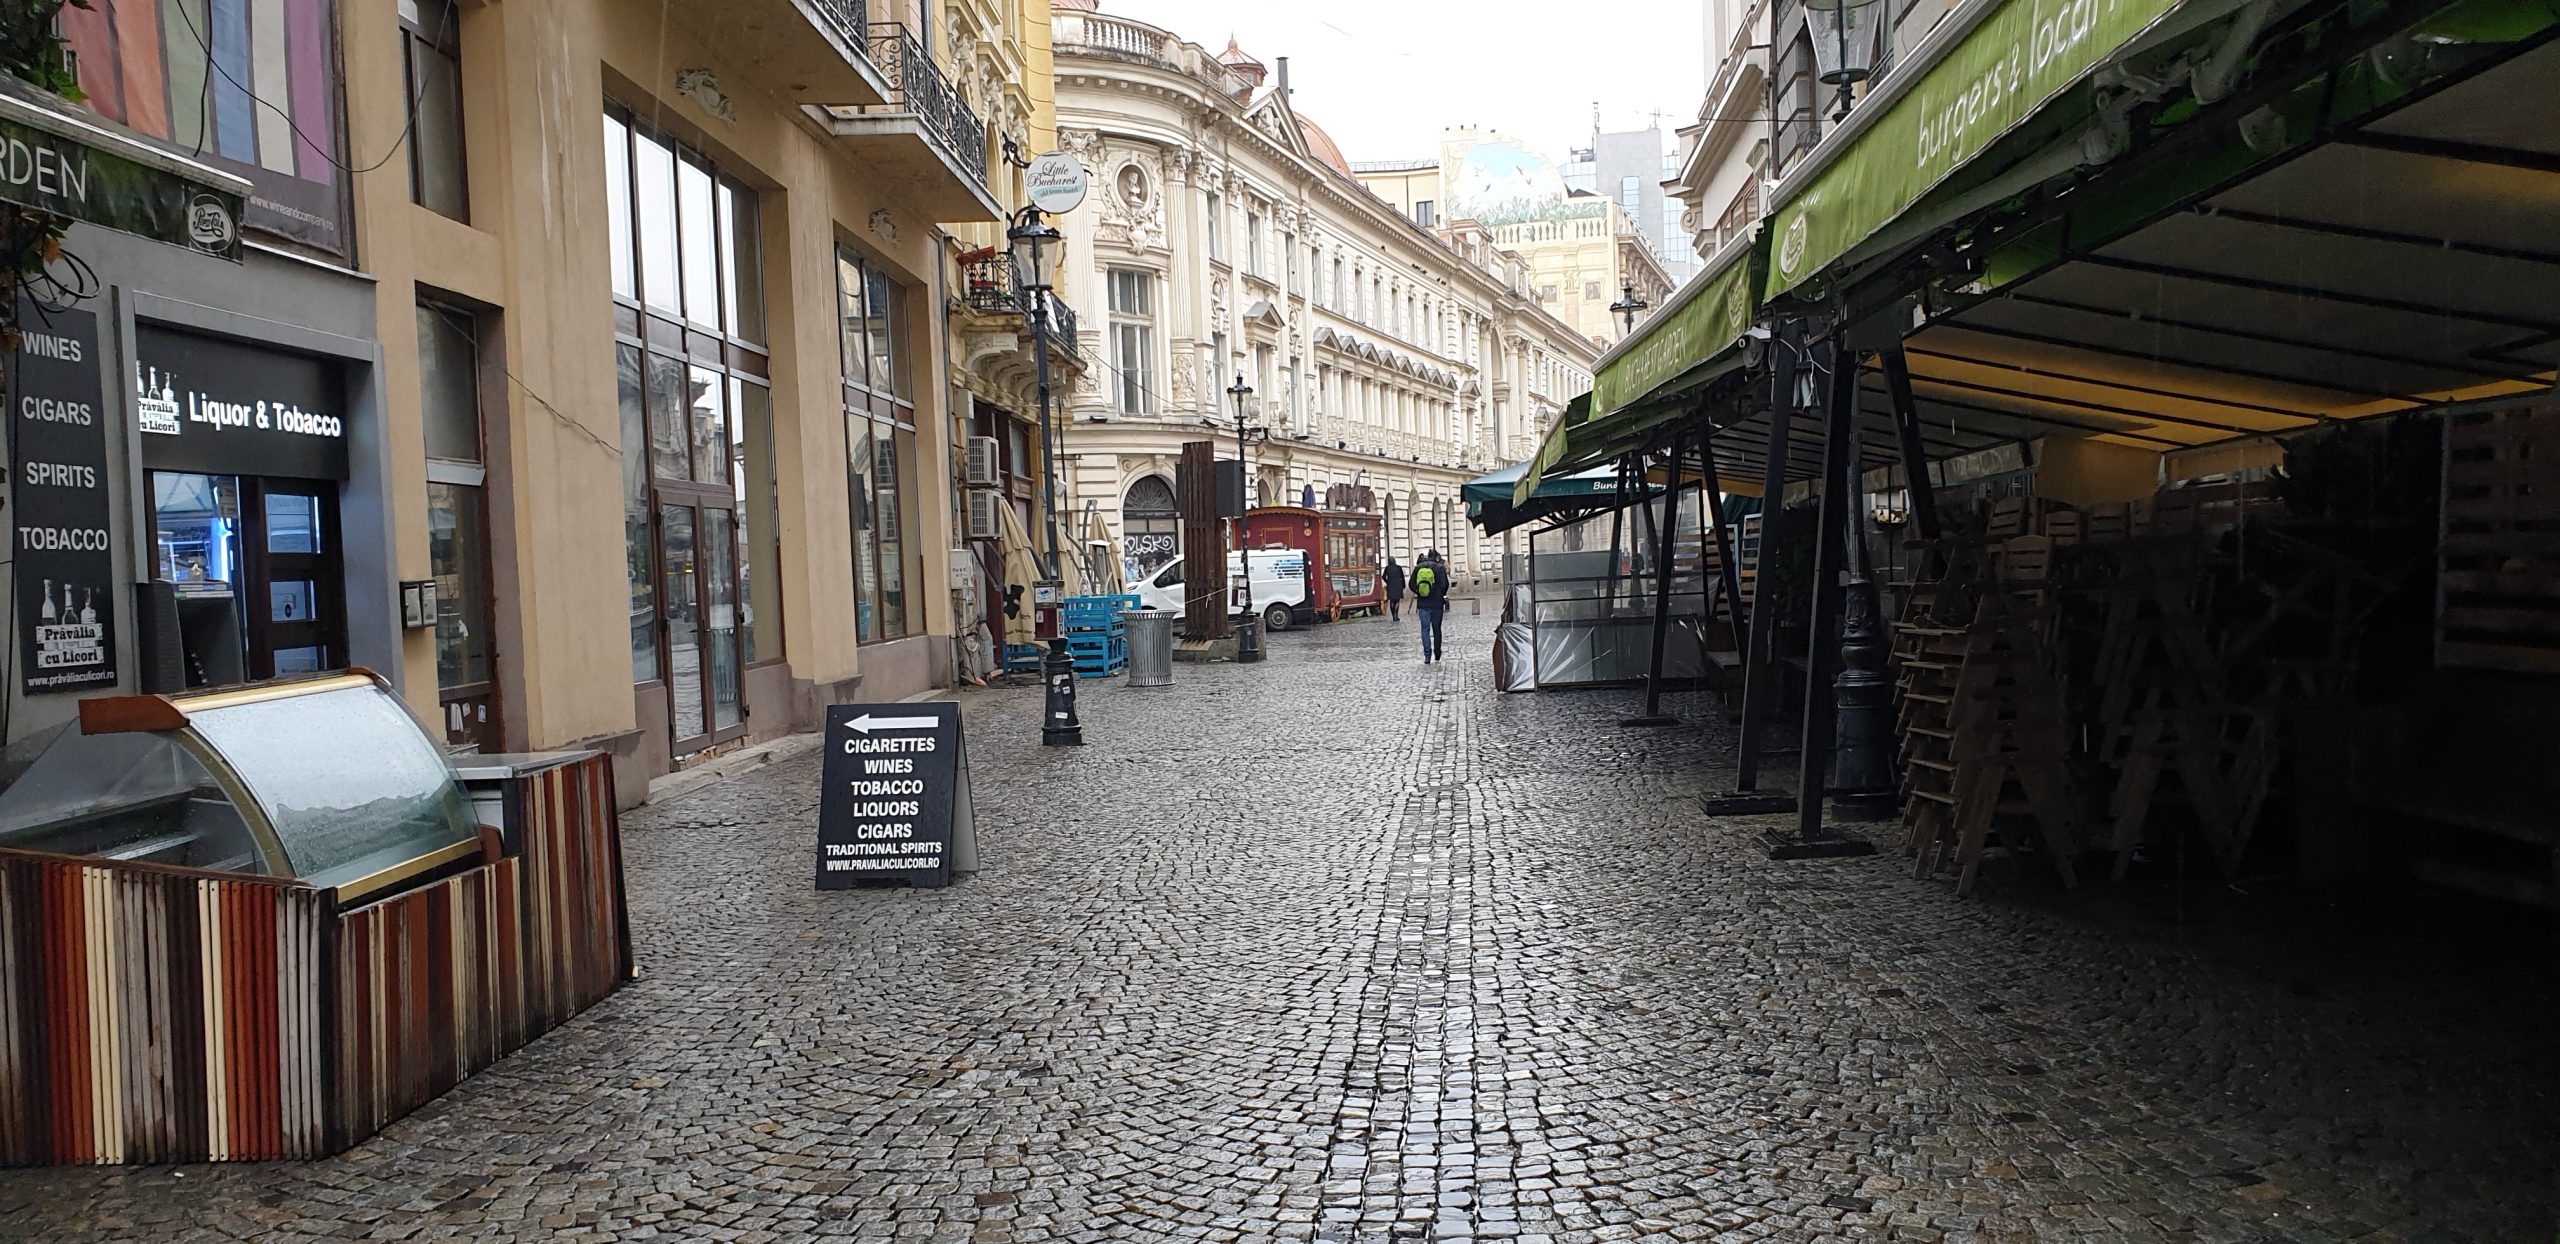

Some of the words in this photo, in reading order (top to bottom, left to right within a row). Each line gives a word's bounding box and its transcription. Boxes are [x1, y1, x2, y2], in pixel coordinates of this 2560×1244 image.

[1917, 60, 2004, 169] burgers
[1042, 161, 1069, 177] Little
[1027, 173, 1077, 187] Bucharest
[249, 195, 334, 232] www.wineandcompany.ro
[22, 330, 82, 362] WINES
[22, 396, 91, 426] CIGARS
[188, 391, 252, 431] Liquor
[255, 400, 270, 430] &
[272, 402, 342, 437] Tobacco
[149, 420, 176, 432] Licori
[26, 461, 96, 489] SPIRITS
[19, 526, 108, 551] TOBACCO
[45, 653, 60, 665] cu
[62, 648, 98, 664] Licori
[844, 736, 936, 754] CIGARETTES
[864, 758, 914, 775] WINES
[851, 779, 924, 796] TOBACCO
[853, 800, 920, 817] LIQUORS
[857, 822, 913, 840] CIGARS
[825, 842, 900, 857] TRADITIONAL
[900, 841, 943, 854] SPIRITS
[826, 857, 940, 872] WWW.PRAVALIACULICORI.RO
